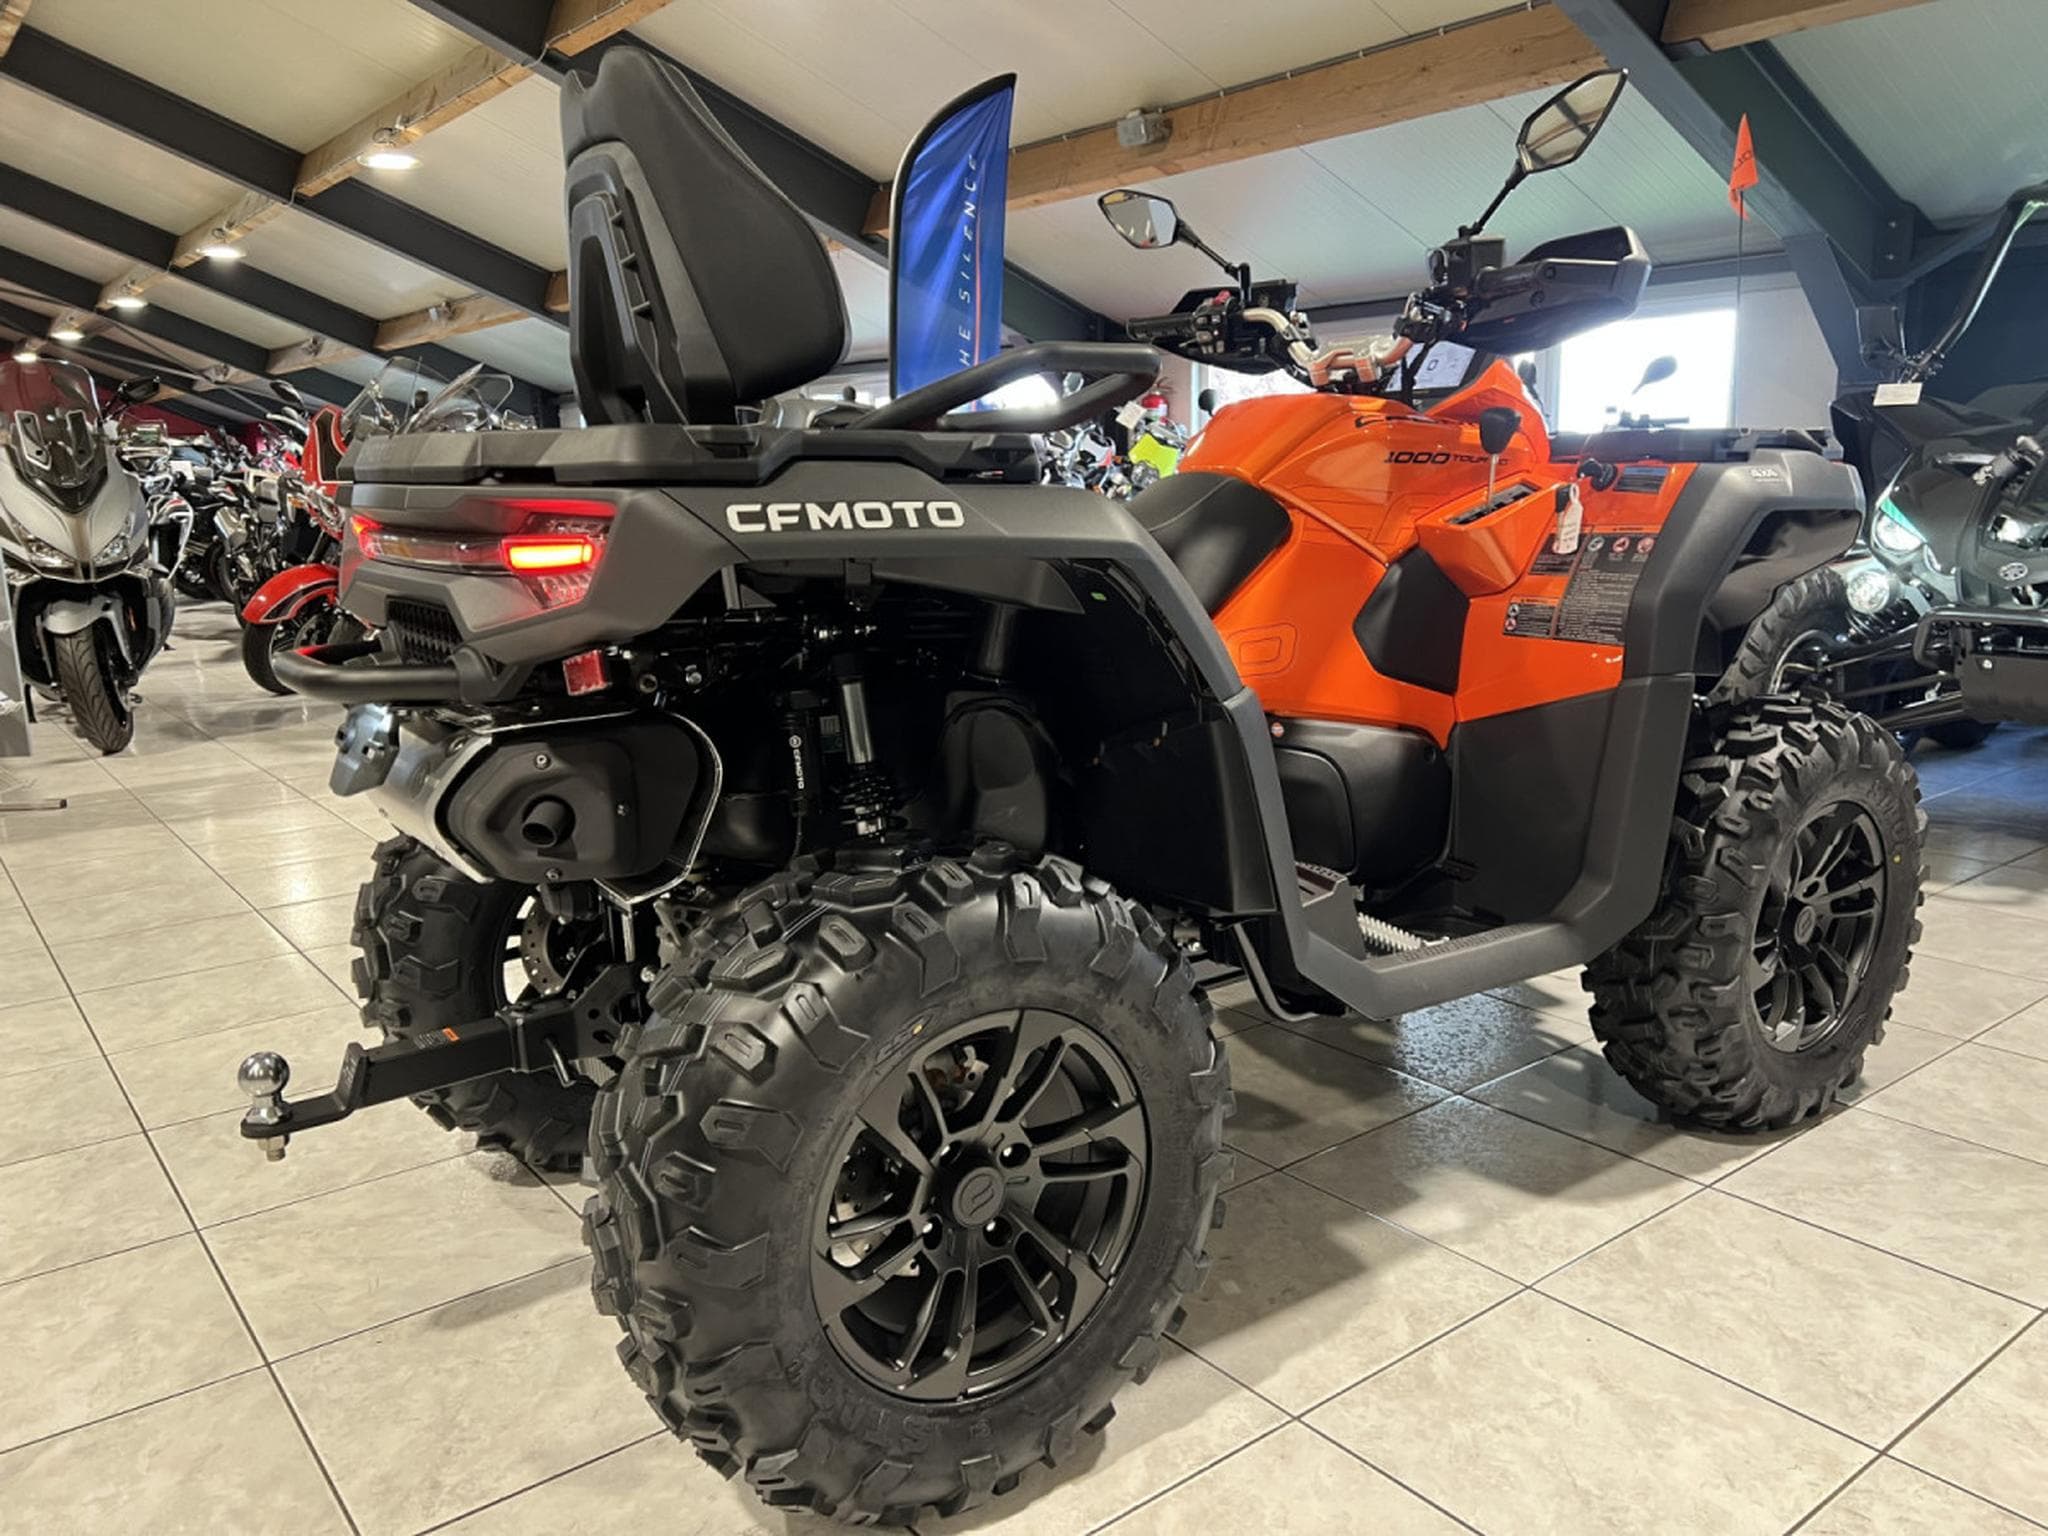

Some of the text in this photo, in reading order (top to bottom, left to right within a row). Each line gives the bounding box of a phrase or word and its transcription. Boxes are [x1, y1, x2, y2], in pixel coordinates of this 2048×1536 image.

[959, 154, 977, 367] HE SILENCE
[1384, 451, 1510, 466] 1000 TOURG
[726, 501, 965, 532] CFMOTO
